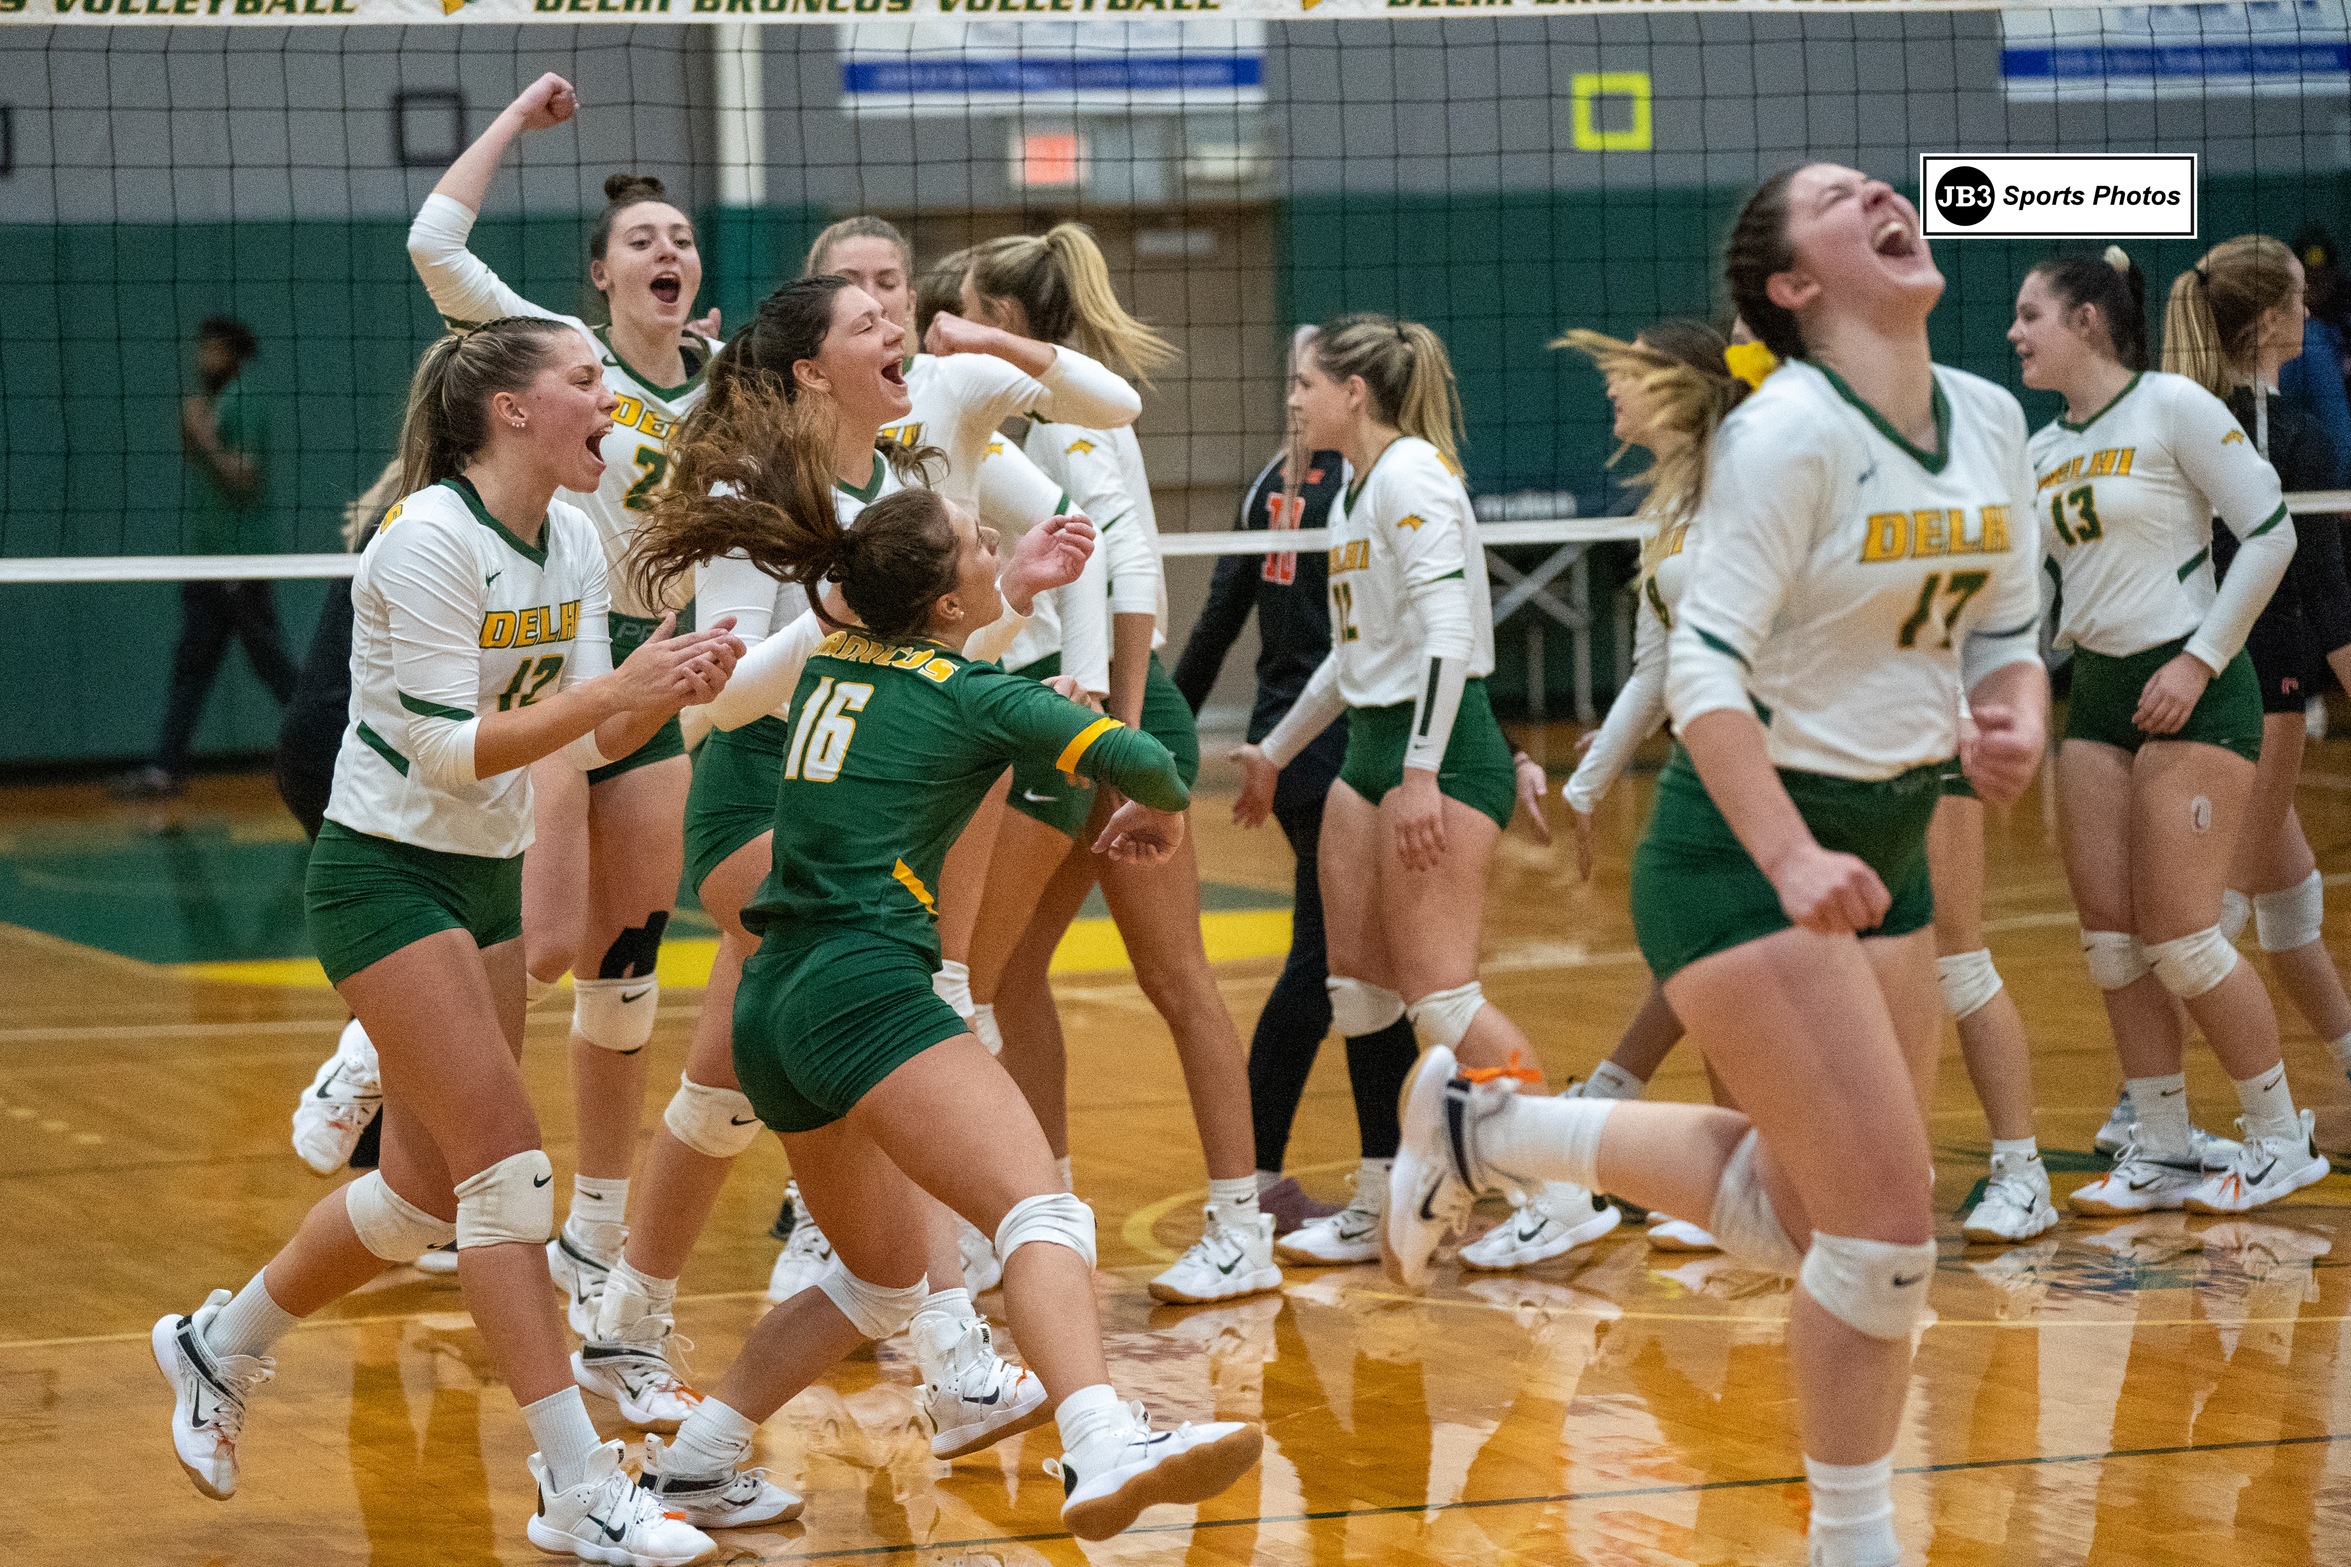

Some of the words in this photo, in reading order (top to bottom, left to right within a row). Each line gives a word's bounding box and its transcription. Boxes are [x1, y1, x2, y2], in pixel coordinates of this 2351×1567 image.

[1859, 503, 2012, 564] DELH
[2052, 484, 2103, 546] 13
[479, 600, 581, 649] DELH
[1896, 568, 1992, 650] 17
[497, 653, 565, 712] 12
[784, 676, 874, 783] 16
